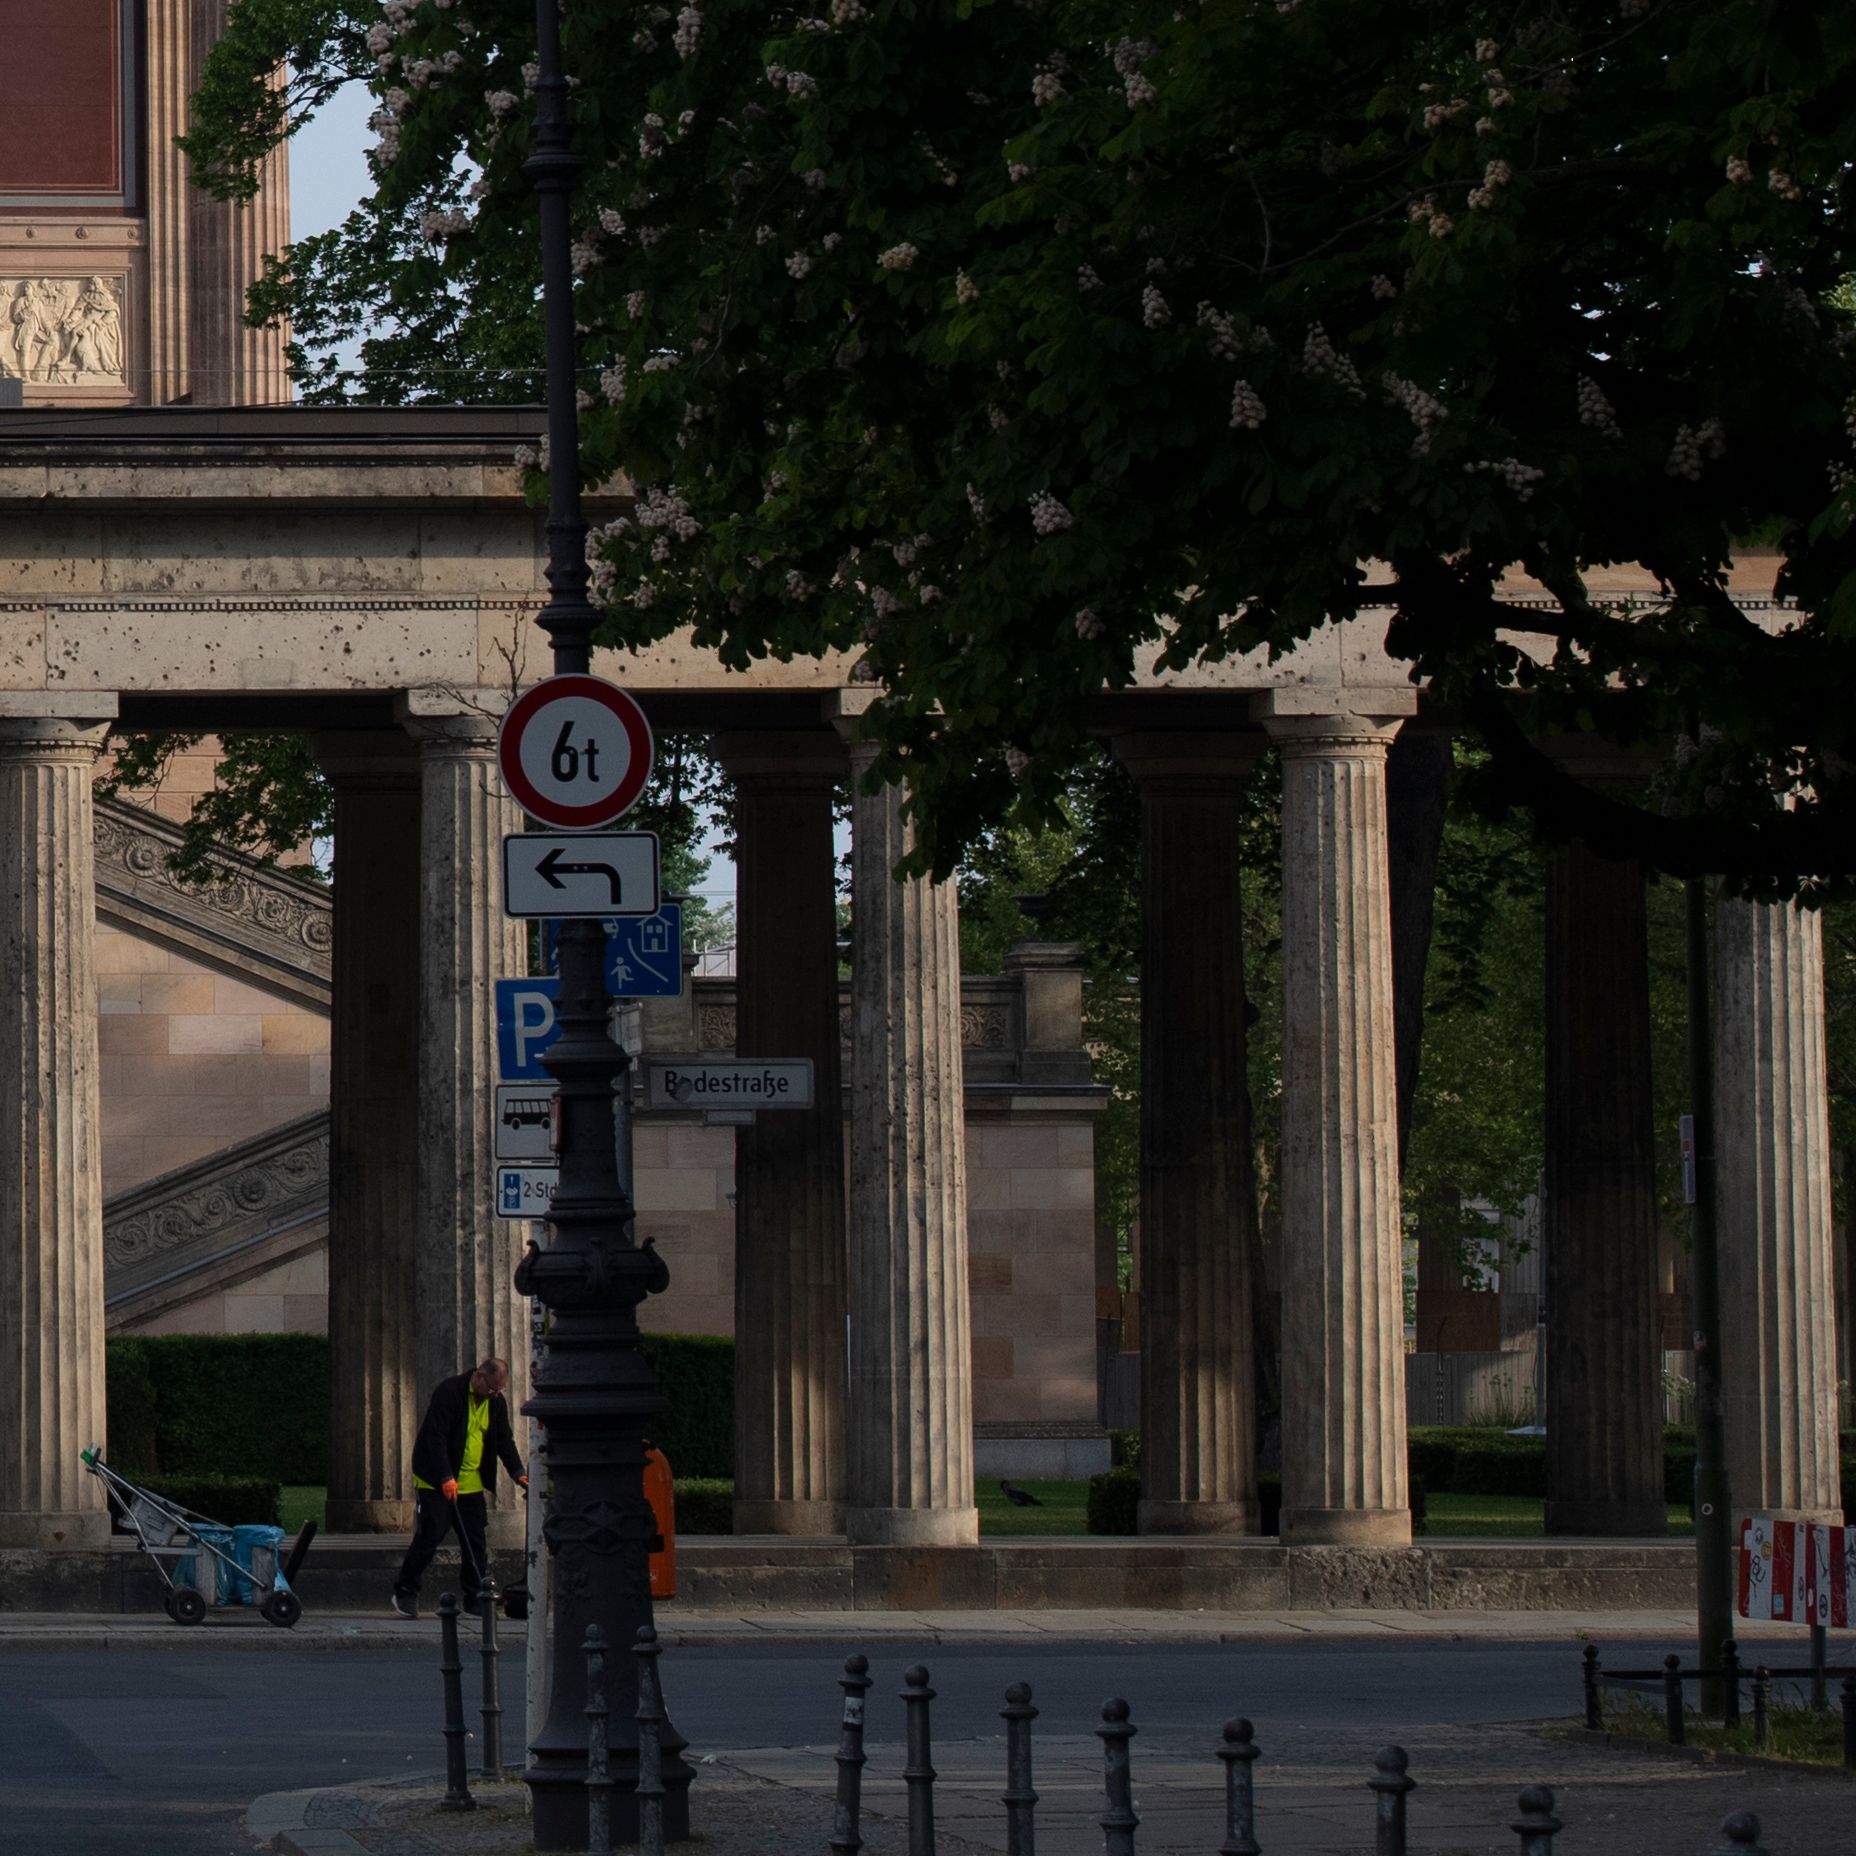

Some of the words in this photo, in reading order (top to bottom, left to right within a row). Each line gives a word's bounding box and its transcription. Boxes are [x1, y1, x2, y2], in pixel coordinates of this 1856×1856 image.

[552, 720, 600, 783] 6t
[513, 991, 555, 1067] P
[524, 1181, 531, 1198] 2
